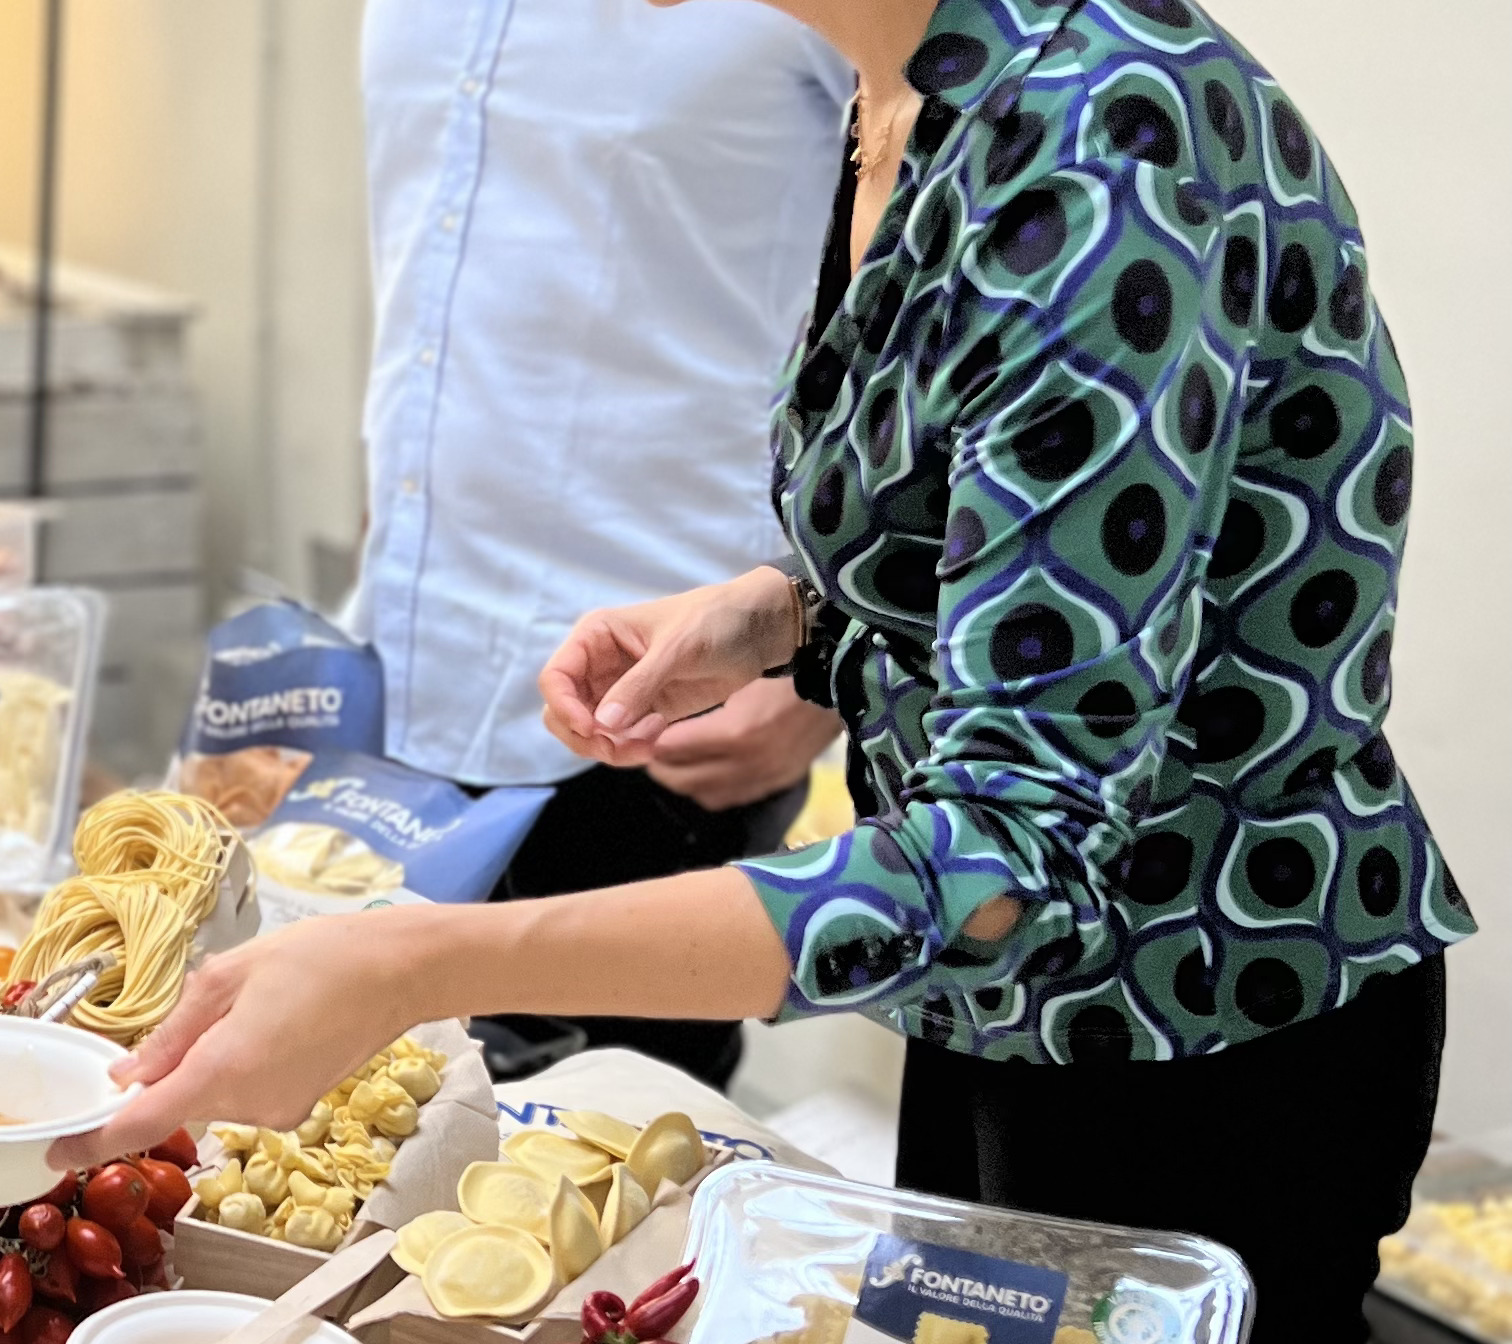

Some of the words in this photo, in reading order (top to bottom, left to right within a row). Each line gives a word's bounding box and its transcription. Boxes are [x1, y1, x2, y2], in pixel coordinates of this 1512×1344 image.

[908, 1283, 918, 1294] IL
[919, 1287, 960, 1305] VALORE
[962, 1297, 996, 1313] DELLA
[910, 1266, 1050, 1314] FONTANETO
